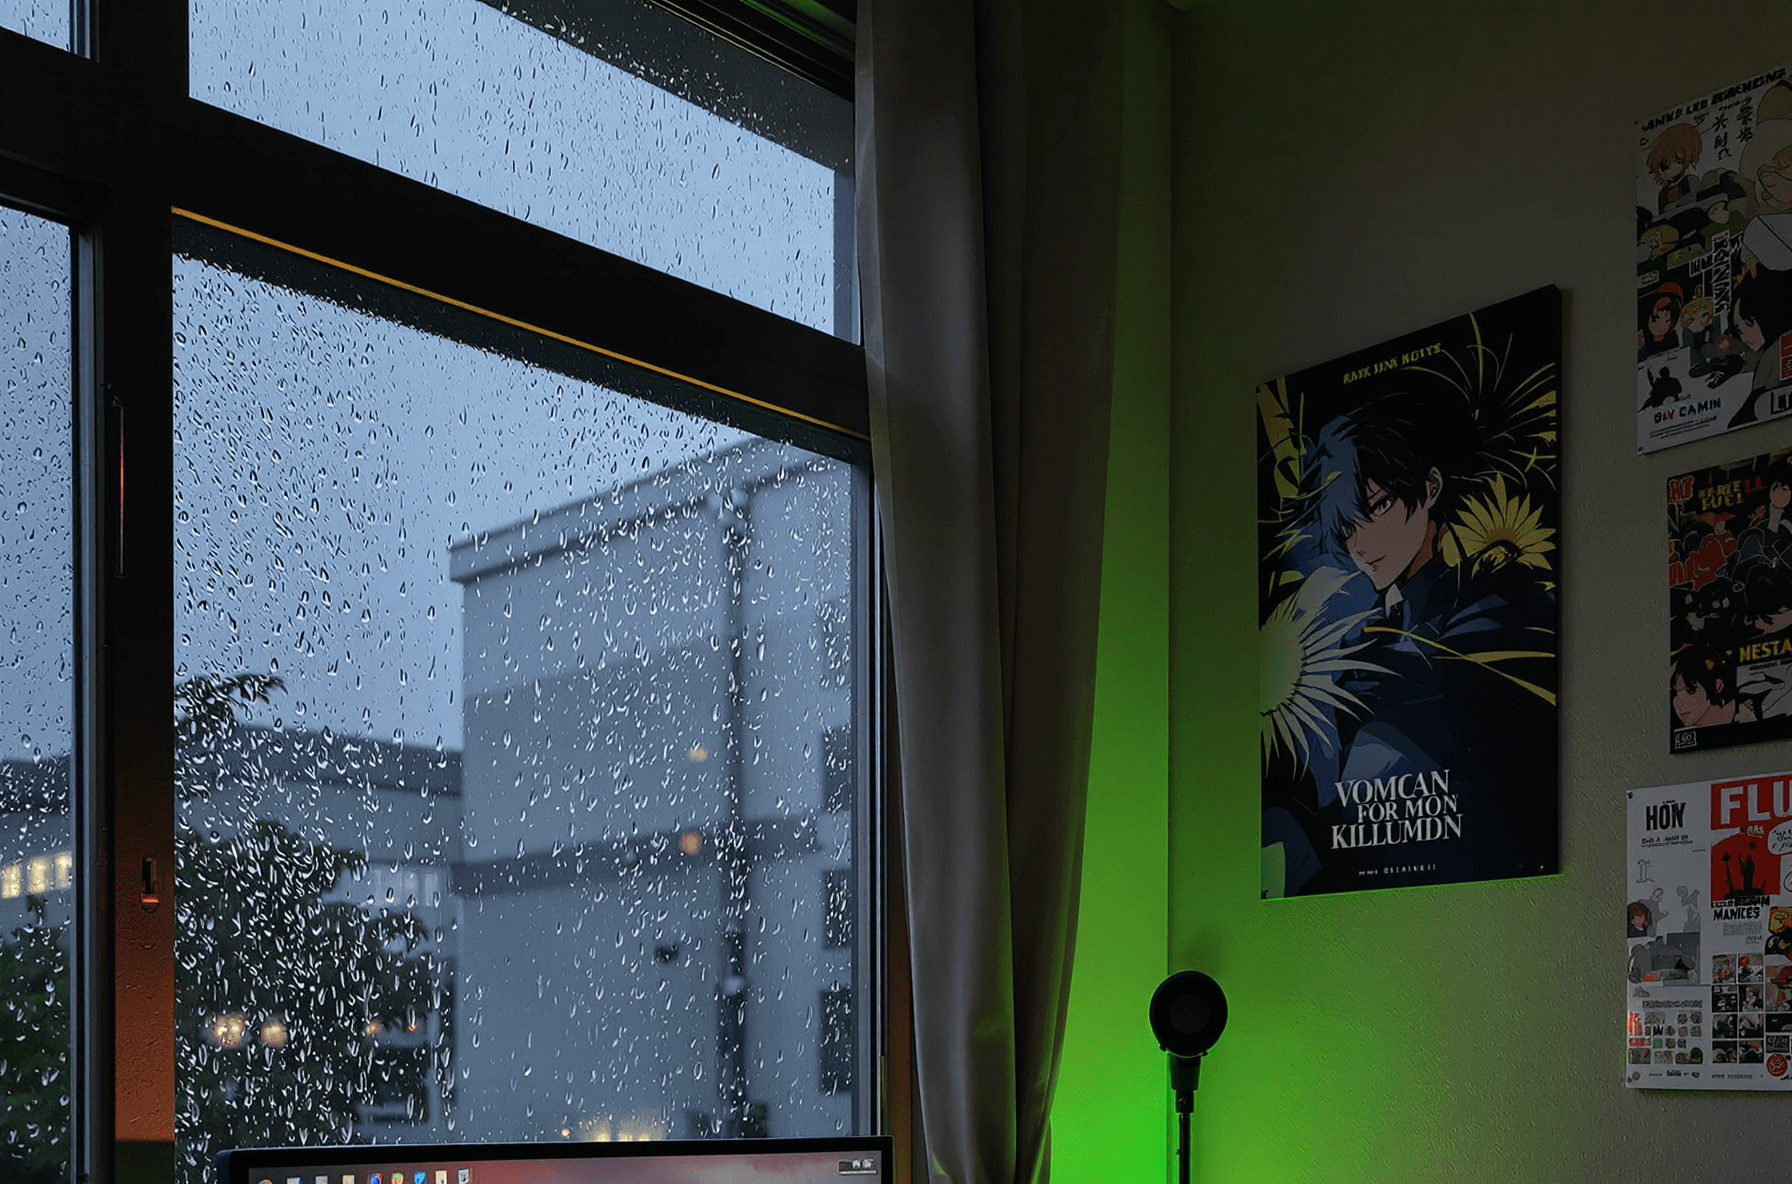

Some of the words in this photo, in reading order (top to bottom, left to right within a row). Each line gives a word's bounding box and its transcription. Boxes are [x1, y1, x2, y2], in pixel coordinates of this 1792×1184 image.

[1334, 768, 1451, 807] VOMCAN
[1357, 801, 1398, 824] FOR
[1405, 794, 1459, 819] MON
[1330, 813, 1464, 850] KILLUMDN
